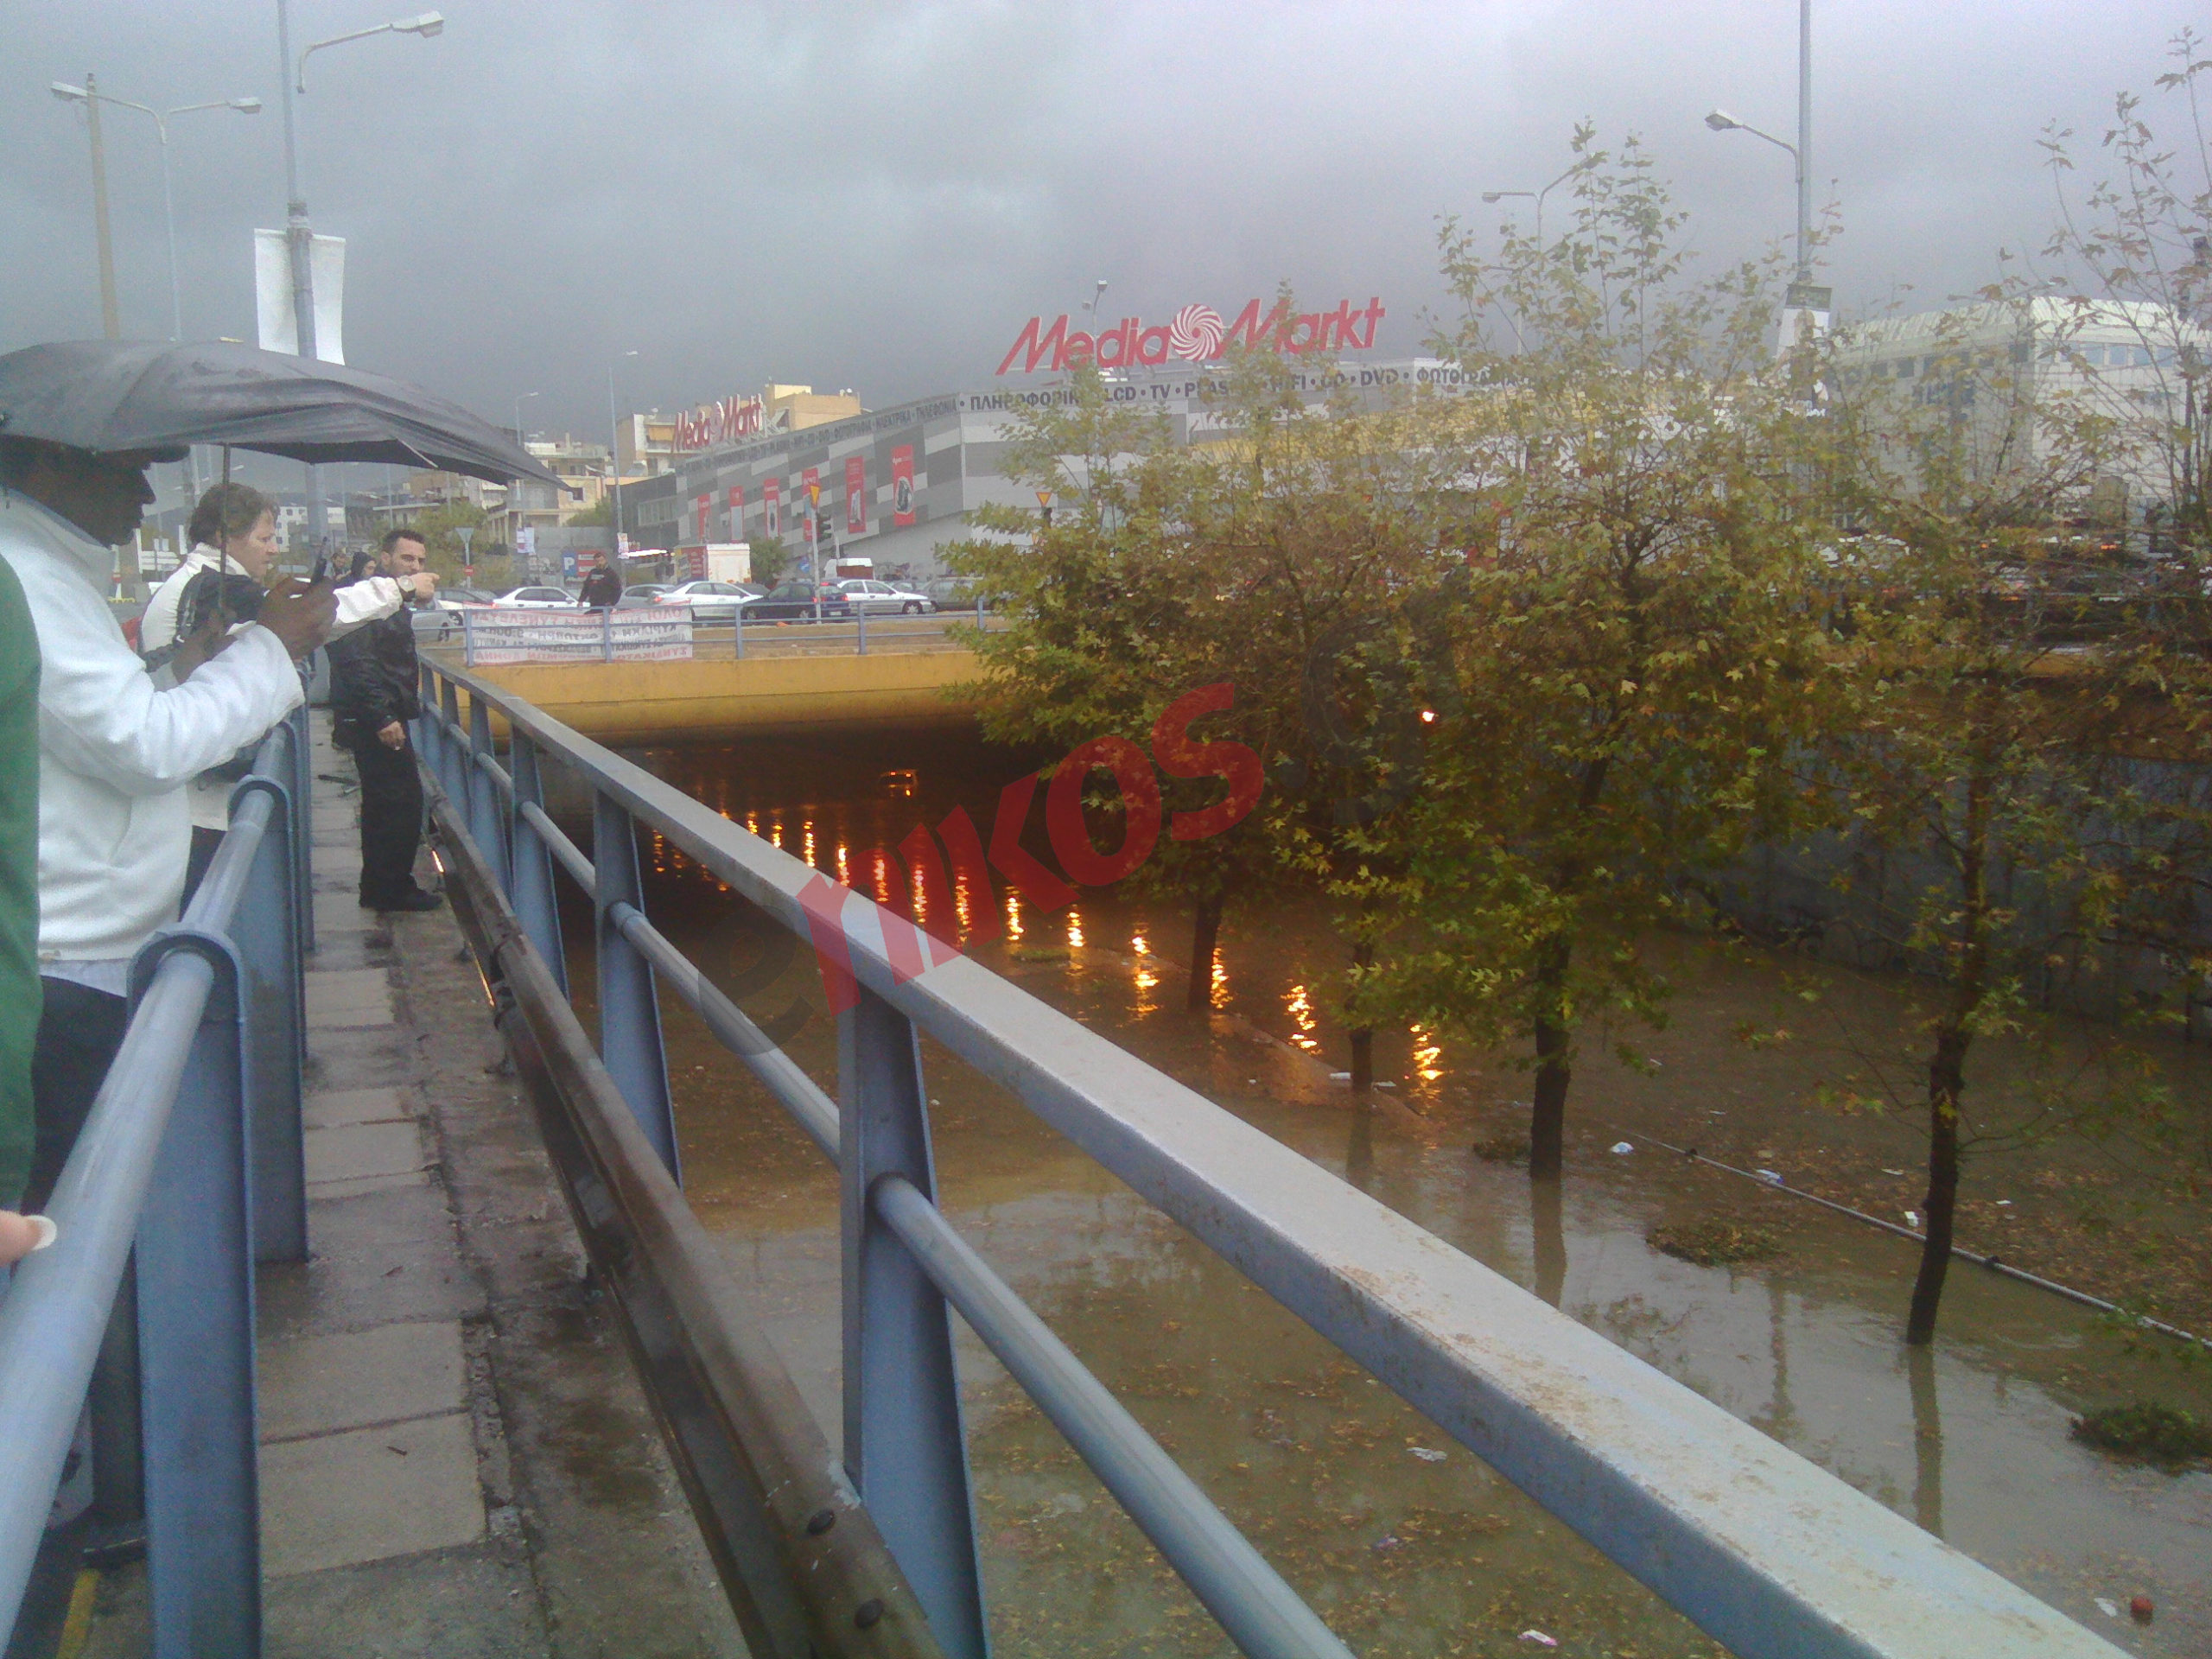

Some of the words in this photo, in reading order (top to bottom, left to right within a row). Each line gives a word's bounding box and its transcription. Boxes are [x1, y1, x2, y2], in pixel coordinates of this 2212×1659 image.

[995, 314, 1170, 375] Media
[1211, 296, 1385, 360] Markt
[970, 391, 1080, 410] ΠΛΗΡΟΦΟΡΙΚ
[1150, 384, 1172, 399] TV
[1361, 367, 1399, 386] DVD
[671, 409, 712, 452] Media
[720, 393, 764, 442] Markt
